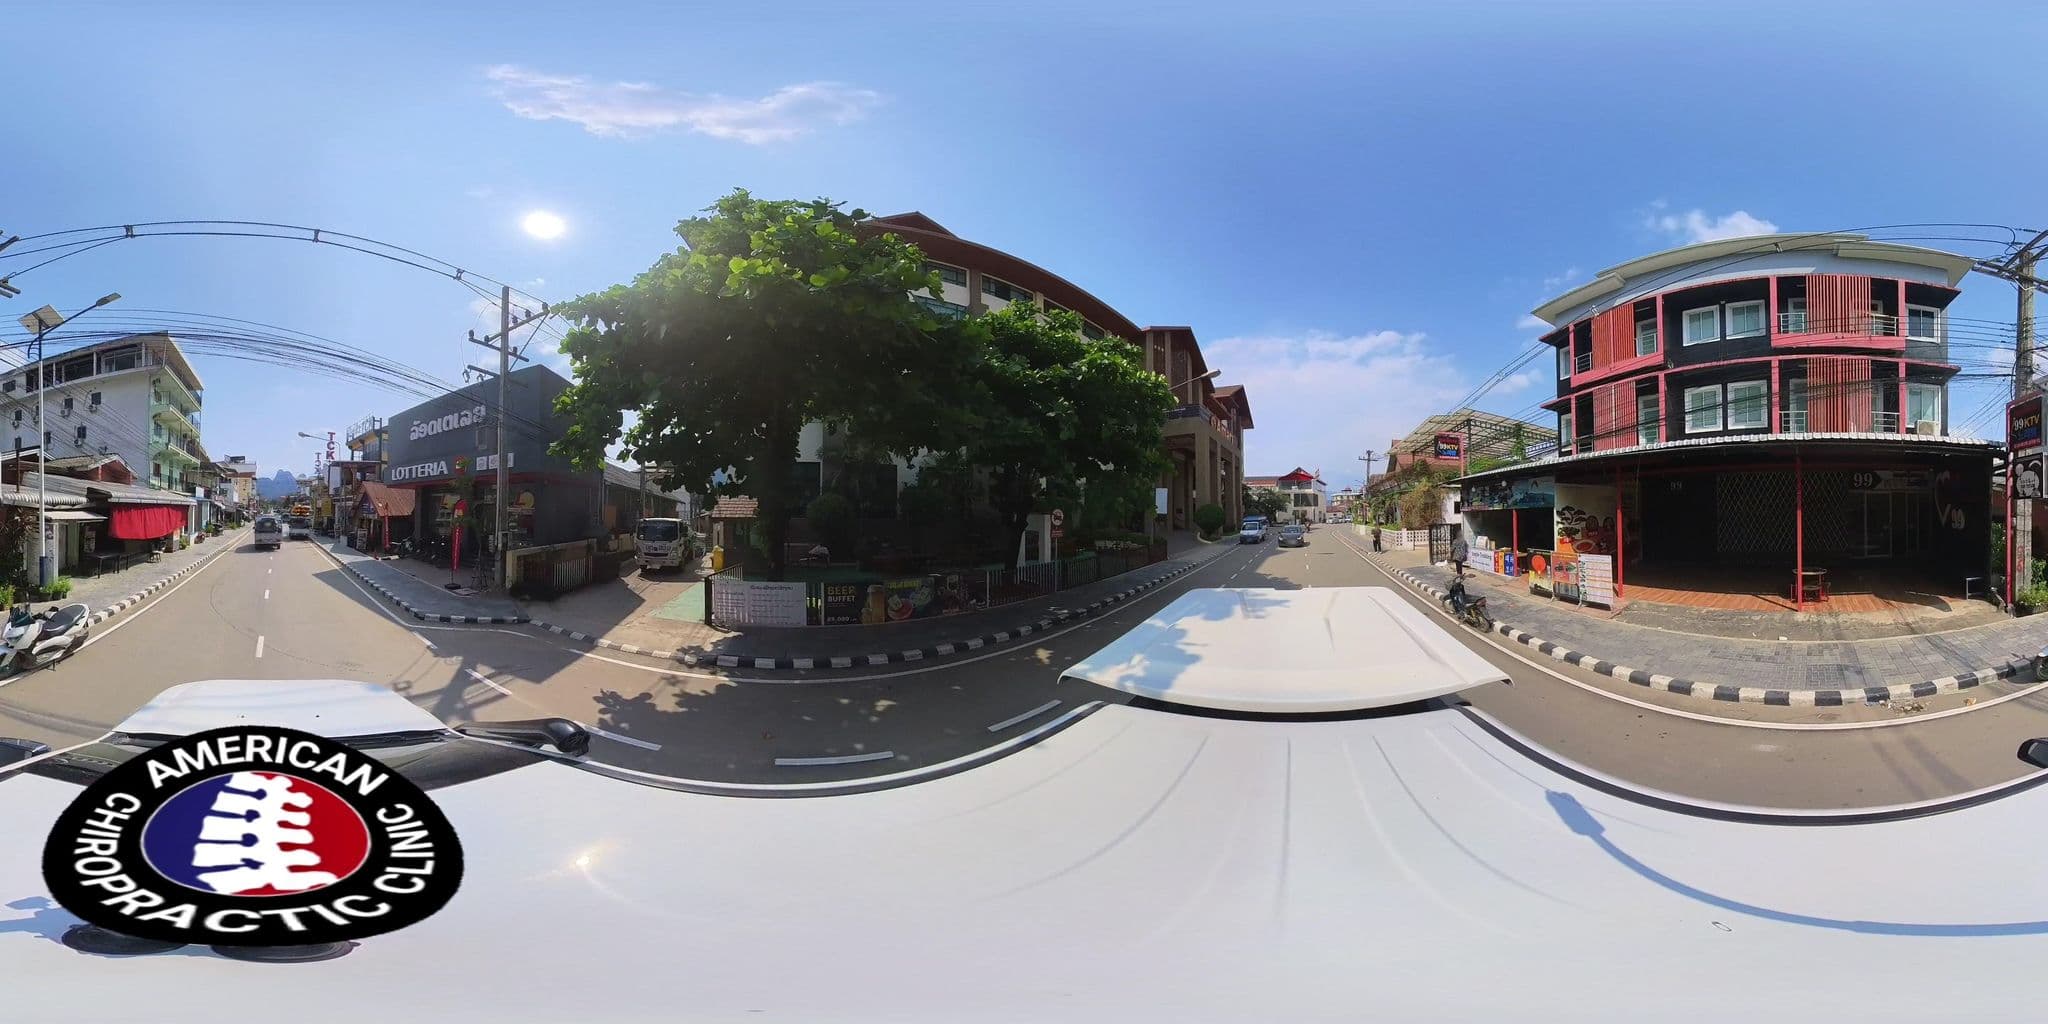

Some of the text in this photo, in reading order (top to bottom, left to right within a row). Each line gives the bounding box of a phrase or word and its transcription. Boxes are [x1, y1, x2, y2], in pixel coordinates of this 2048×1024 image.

[326, 432, 336, 460] TCK
[391, 460, 449, 481] LOTTERIA
[1853, 472, 1873, 487] 99
[827, 585, 857, 595] BEER
